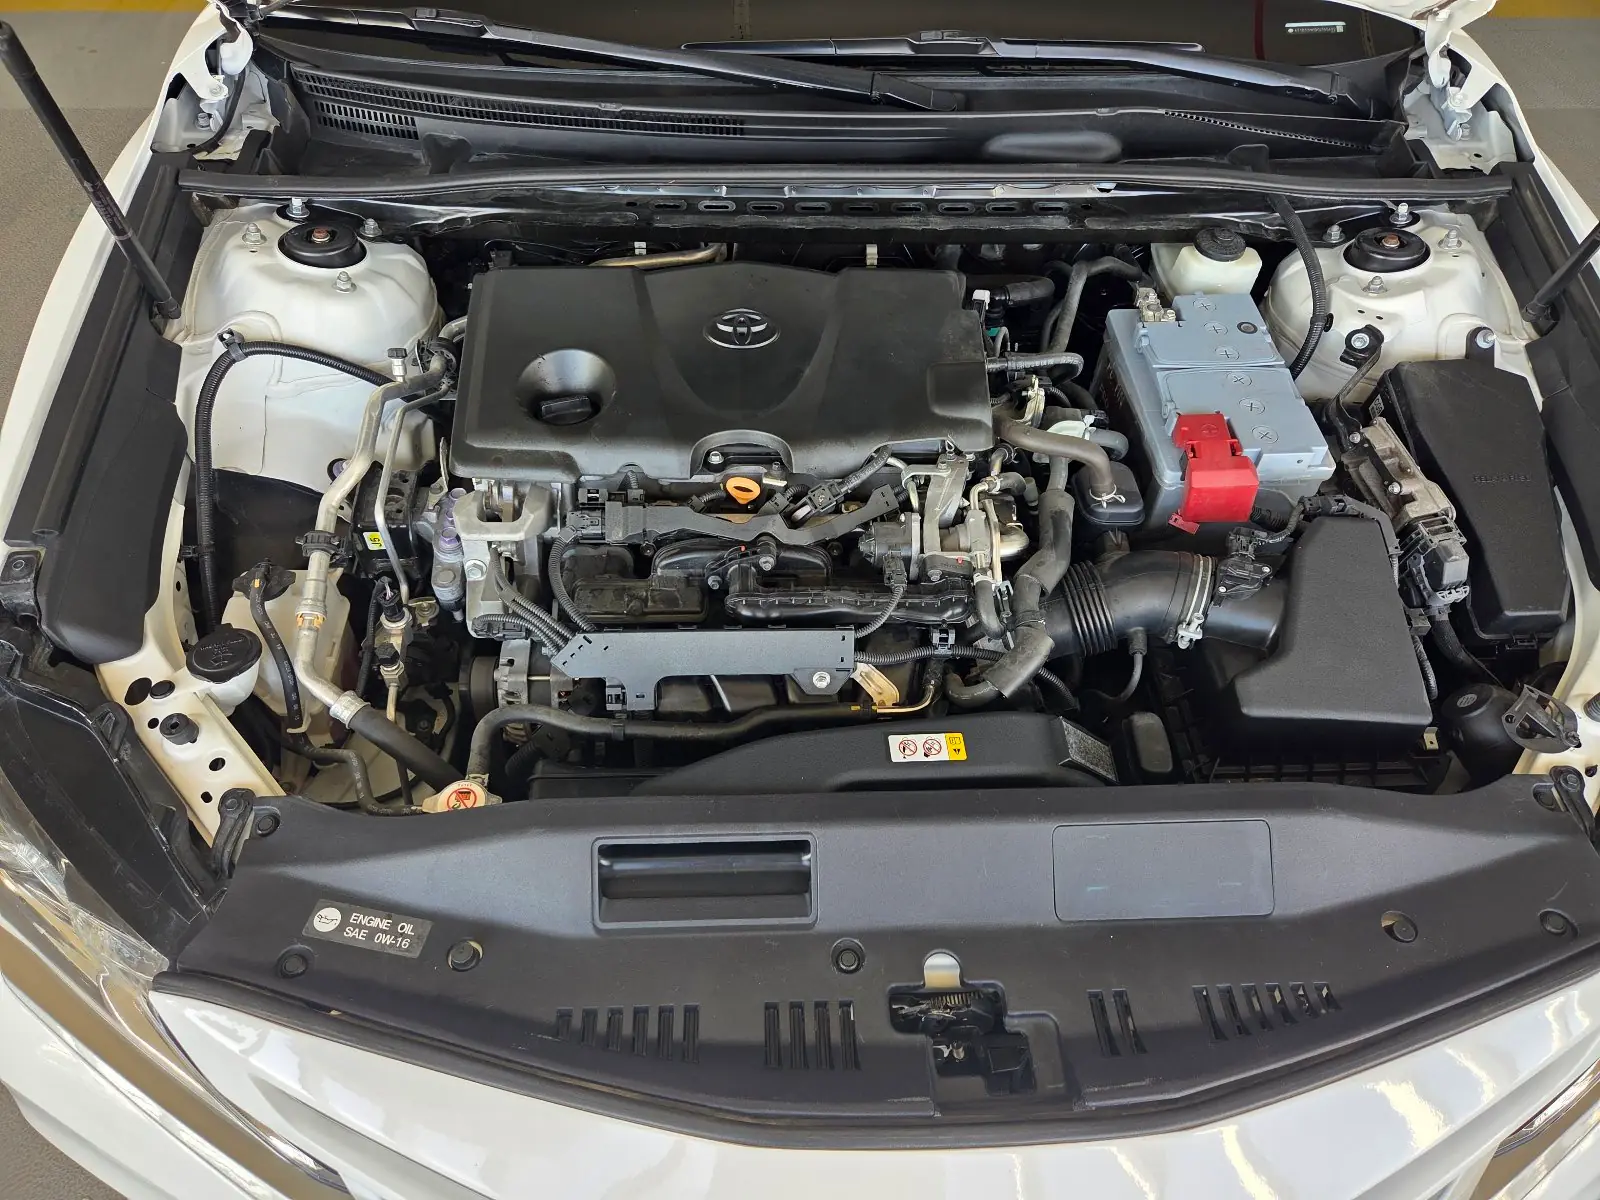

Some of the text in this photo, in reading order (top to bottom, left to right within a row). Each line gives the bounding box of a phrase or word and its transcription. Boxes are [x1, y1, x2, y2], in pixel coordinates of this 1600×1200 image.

[349, 912, 415, 936] ENGINE OIL
[343, 926, 411, 949] SAE 0W-16
